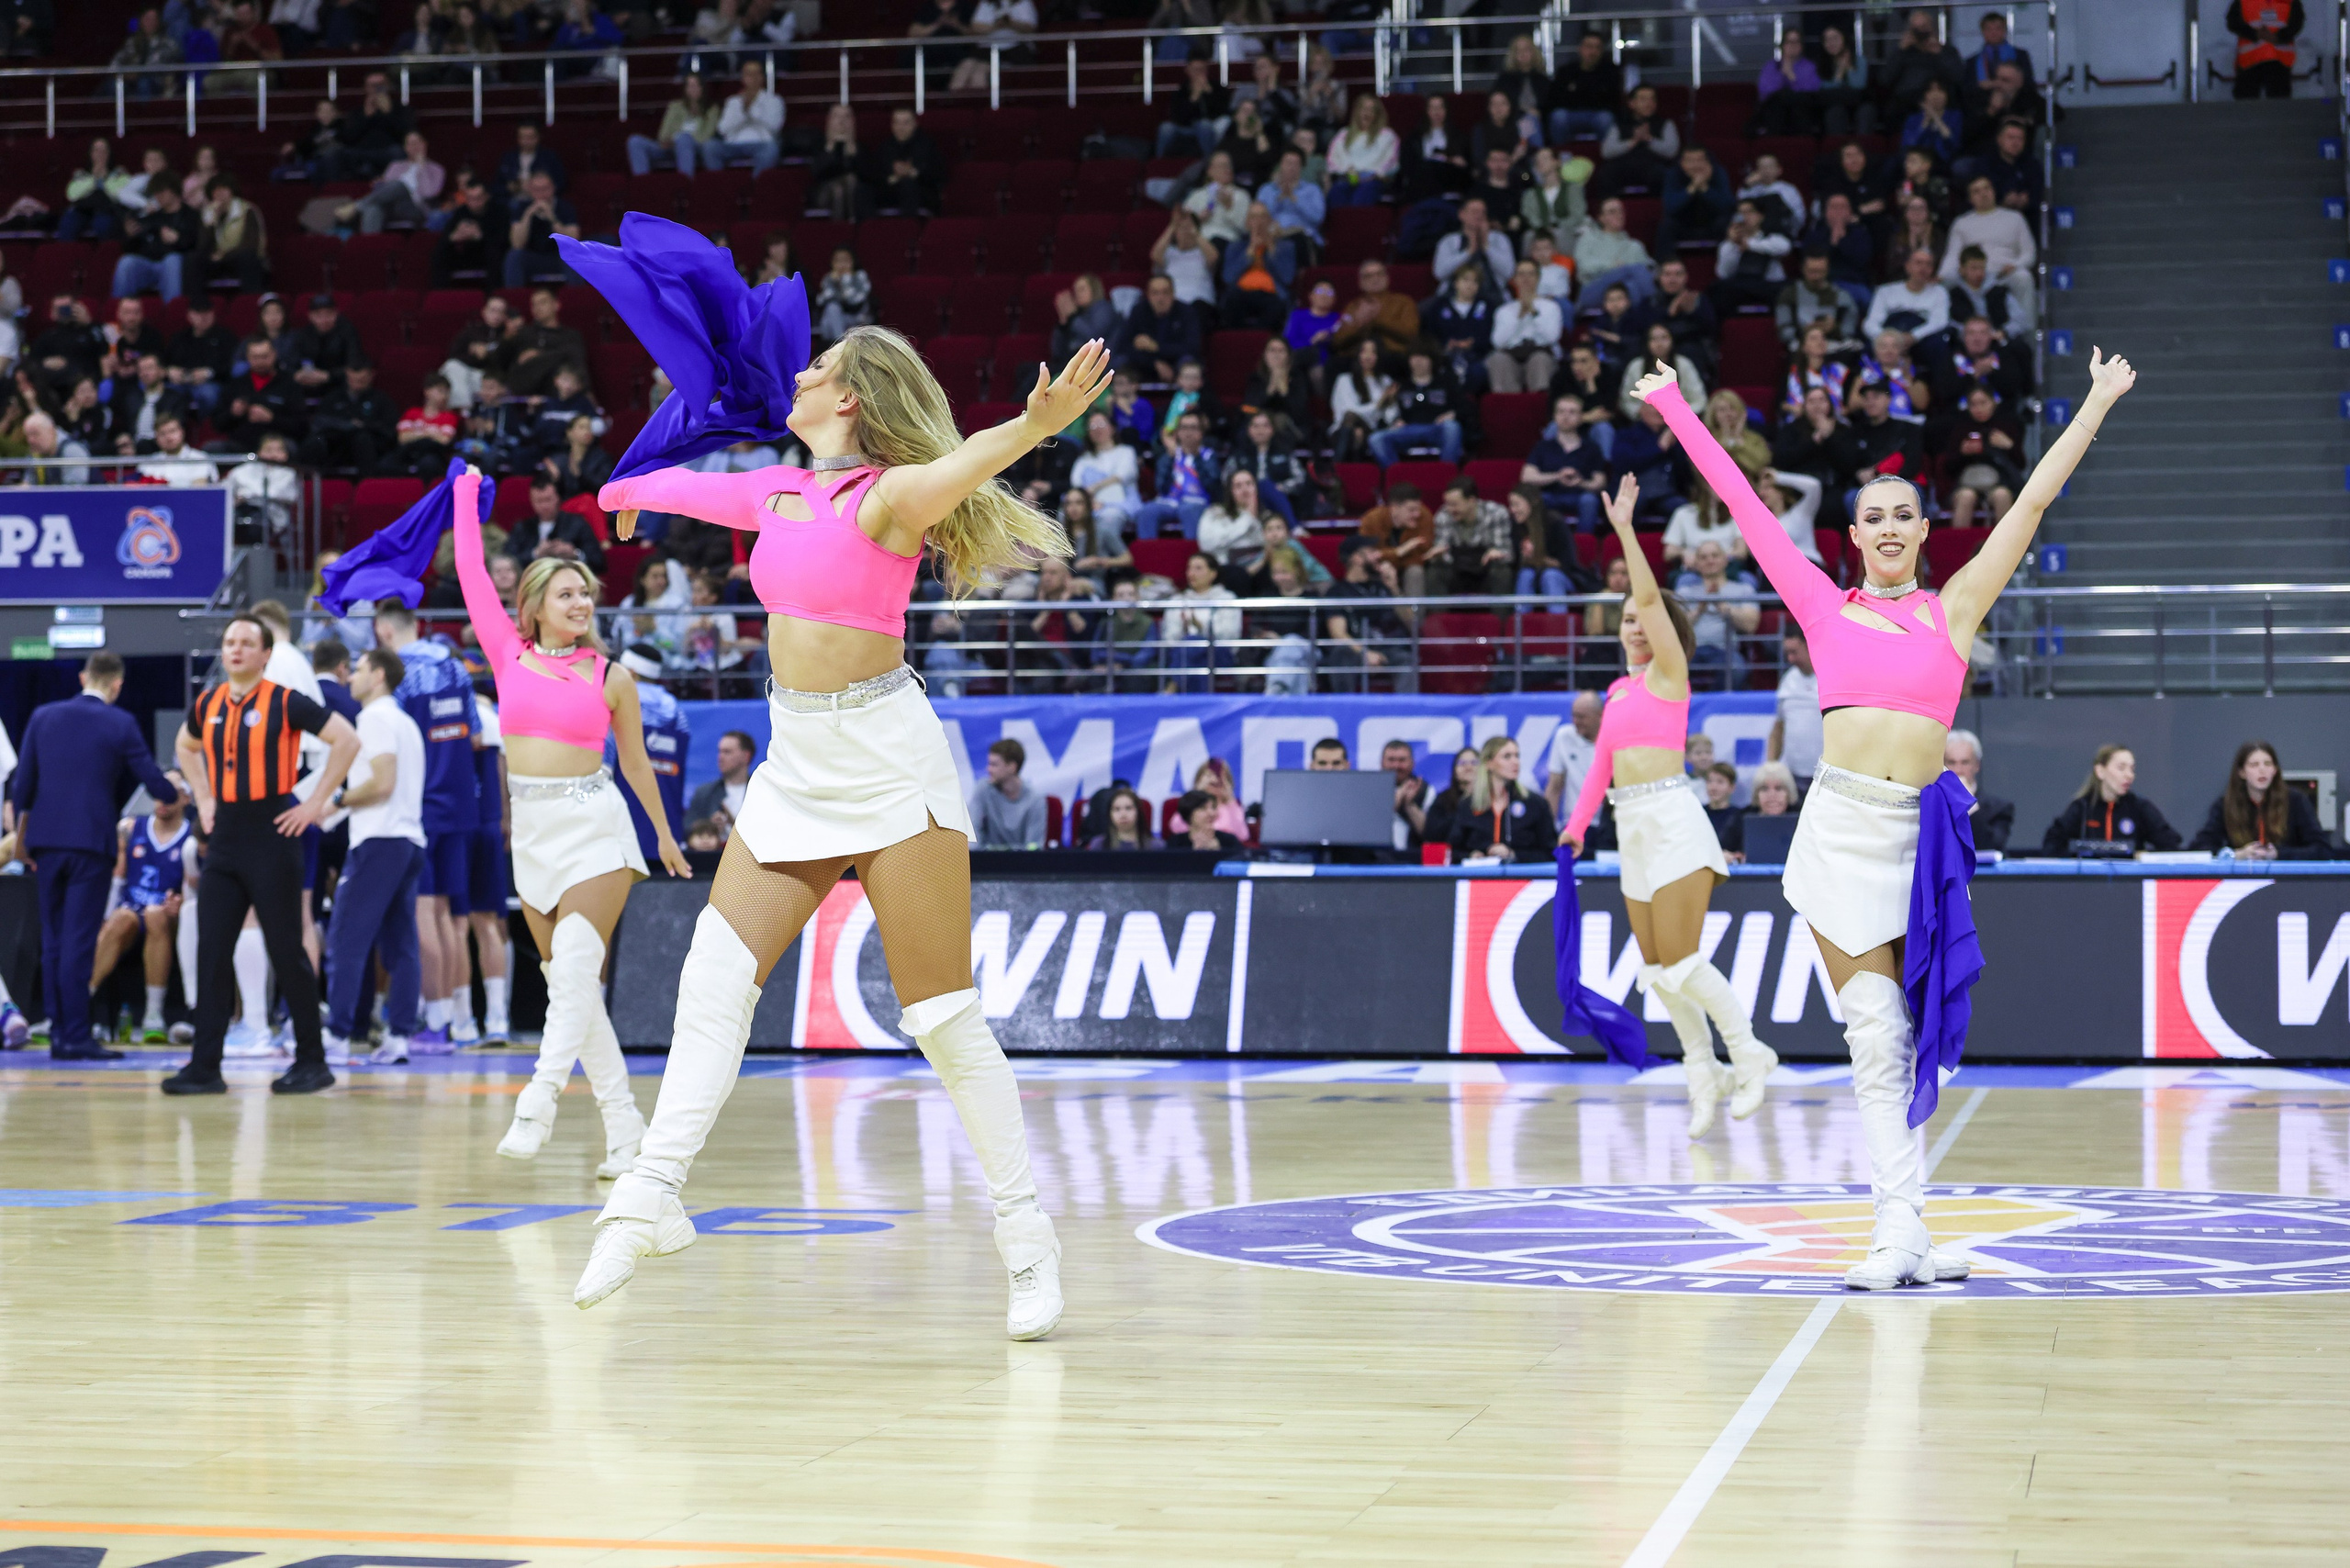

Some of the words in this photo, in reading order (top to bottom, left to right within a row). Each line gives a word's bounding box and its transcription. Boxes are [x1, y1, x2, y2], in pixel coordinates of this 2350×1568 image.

[970, 911, 1216, 1020] WIN
[113, 1200, 921, 1236] ВТБ
[1240, 1243, 1431, 1267] VTB
